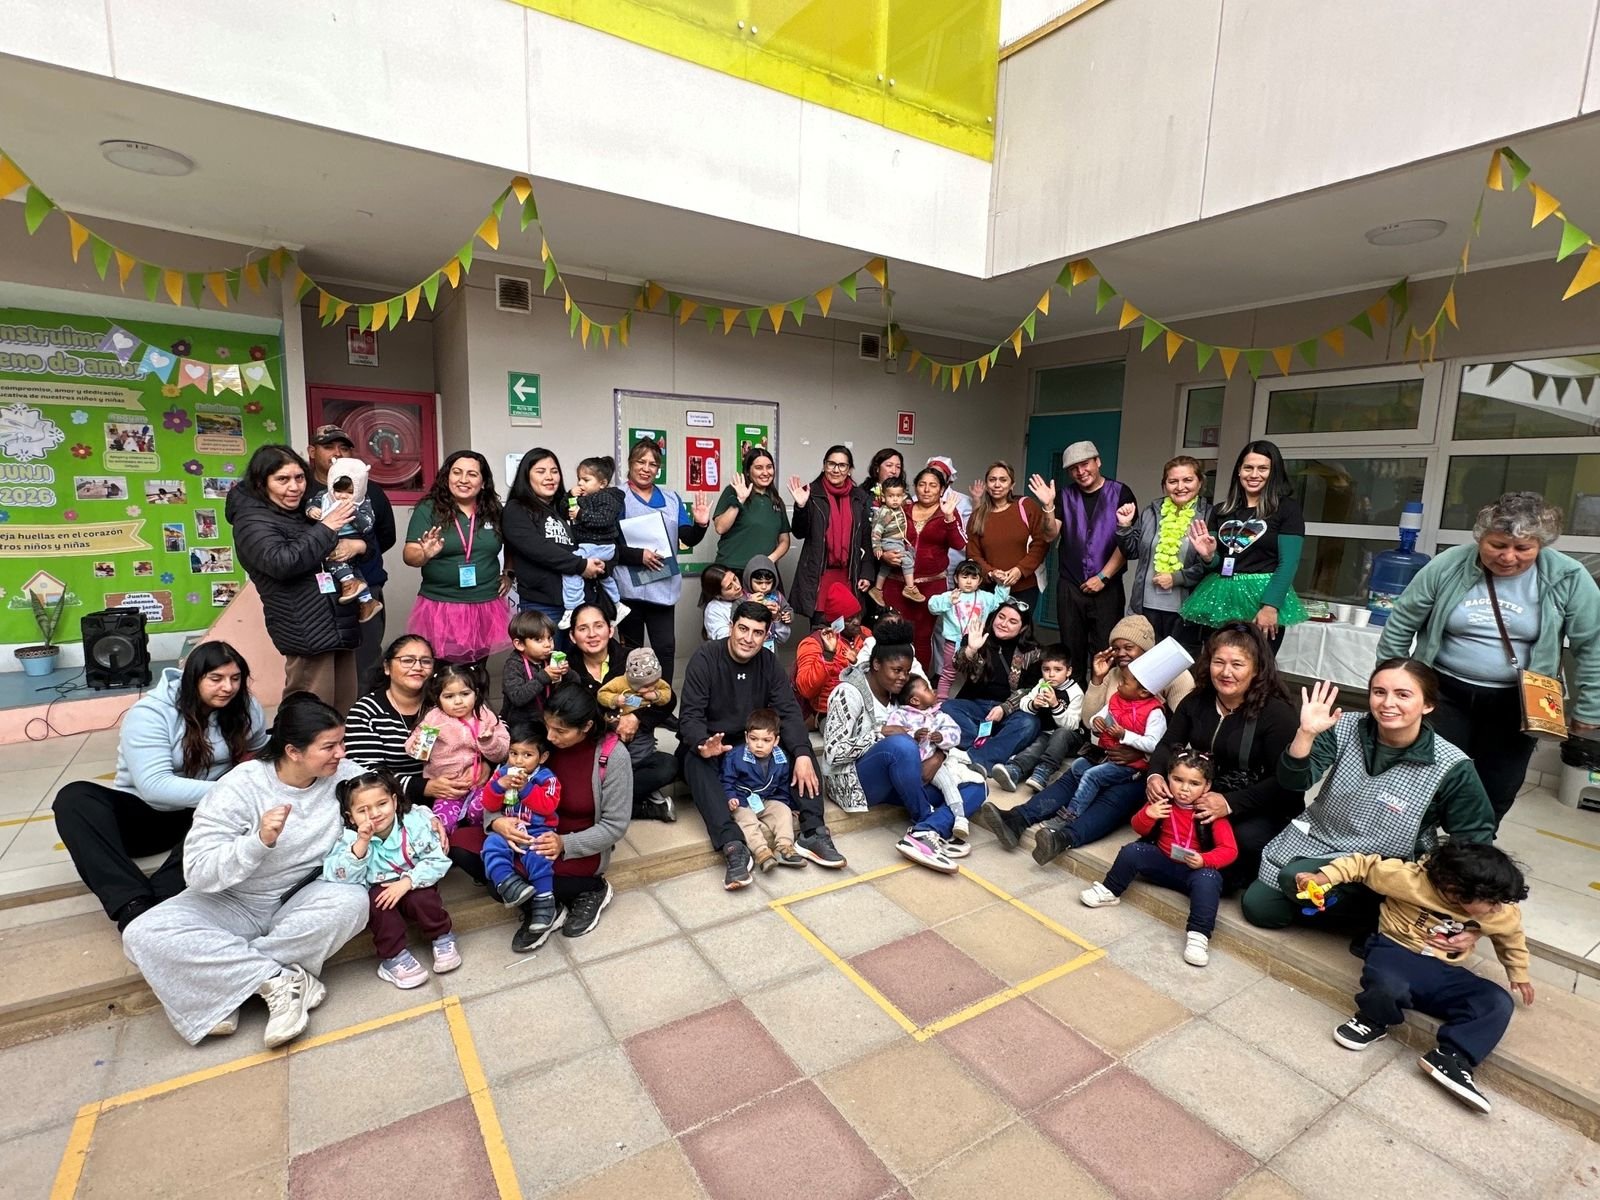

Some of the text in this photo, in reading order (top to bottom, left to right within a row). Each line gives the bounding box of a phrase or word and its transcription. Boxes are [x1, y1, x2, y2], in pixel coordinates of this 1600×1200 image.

[0, 351, 44, 371] eno
[48, 351, 81, 373] de
[76, 394, 97, 402] niños
[83, 388, 124, 397] dedicación
[0, 488, 52, 504] 2026
[0, 533, 16, 541] eja
[18, 532, 55, 540] huellas
[72, 531, 81, 539] el
[83, 528, 123, 538] corazón
[0, 541, 91, 551] tros niños y niñas
[1465, 598, 1524, 614] BAGUTTES
